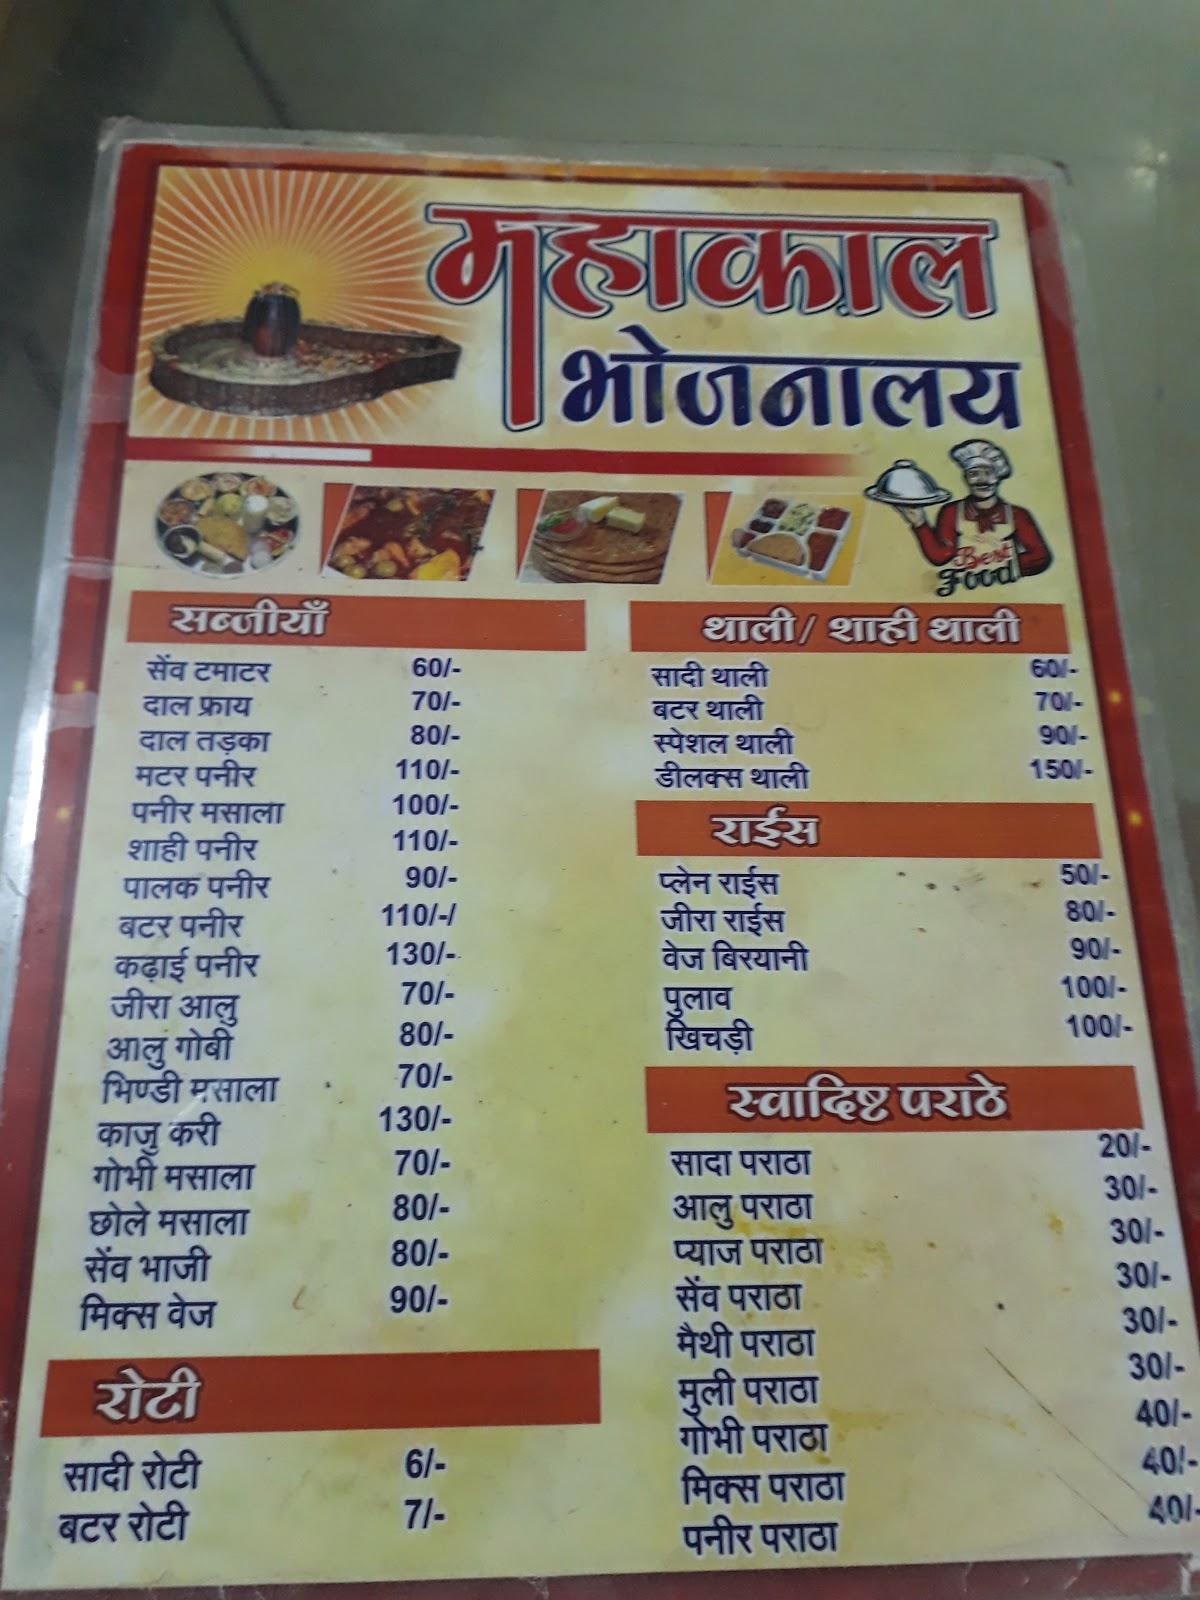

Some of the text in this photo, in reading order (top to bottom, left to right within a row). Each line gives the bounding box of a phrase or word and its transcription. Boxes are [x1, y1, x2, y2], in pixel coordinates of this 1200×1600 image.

[424, 202, 999, 433] महाकाल
[560, 323, 1023, 430] भोजनालय
[169, 598, 331, 636] सब्जीयाँ
[827, 607, 919, 645] शाही
[927, 606, 1022, 644] थाली
[147, 654, 461, 683] सेंव टमाटर 60/-
[651, 659, 1078, 688] सादी थाली 60/-
[143, 691, 461, 717] दाल फ्राय 70/-
[653, 692, 1083, 722] बटर थाली 70/-
[138, 725, 461, 756] दाल तड़का 80/-
[654, 725, 1088, 756] स्पेशल थाली 90/-
[136, 758, 460, 787] मटर पनीर 110/-
[654, 759, 1094, 790] डीलक्स थाली 150/-
[132, 794, 459, 824] पनीर मसाला 100/-
[710, 807, 821, 849] राईस
[127, 829, 459, 862] शाही पनीर 110/-
[123, 866, 458, 899] पालक पनीर 90/-
[659, 863, 1110, 899] प्लेन राईस 50/-
[119, 903, 457, 939] बटर पनीर 110/-/
[660, 900, 1115, 936] जीरा राईस 80/-
[114, 941, 456, 983] कढ़ाई पनीर 130/-
[662, 938, 1121, 972] वेज बिरयानी 90/-
[111, 981, 455, 1026] जीरा आलु 70/-
[664, 976, 1128, 1016] पुलाव 100/-
[107, 1021, 454, 1069] आलु गोबी 80/-
[666, 1015, 1133, 1055] खिचड़ी 100/-
[102, 1063, 453, 1105] भिण्डी मसाला 70/-
[726, 1072, 1009, 1122] स्वादिष्ट पराठे
[98, 1105, 452, 1155] काजु करी 130/-
[93, 1149, 451, 1192] गोभी मसाला 70/-
[671, 1133, 1151, 1177] सादा पराठा 20/-
[89, 1193, 450, 1237] छोले मसाला 80/-
[673, 1174, 1158, 1229] आलु पराठा 30/-
[85, 1238, 449, 1283] सेंव भाजी 80/-
[674, 1218, 1164, 1267] प्याज पराठा 30/-
[80, 1284, 448, 1331] मिक्स वेज 90/-
[675, 1262, 1171, 1312] सेंव पराठा 30/-
[676, 1306, 1177, 1360] मैथी पराठा 30/-
[96, 1364, 202, 1422] रोटी
[679, 1352, 1184, 1415] मुली पराठा 30/-
[679, 1398, 1191, 1456] गोभी पराठा 40/-
[64, 1448, 446, 1492] सादी रोटी 6/-
[682, 1446, 1198, 1505] मिक्स पराठा 40/-
[59, 1498, 445, 1543] बटर रोटी 7/-
[683, 1516, 752, 1556] पनीर
[761, 1522, 838, 1553] पराठा
